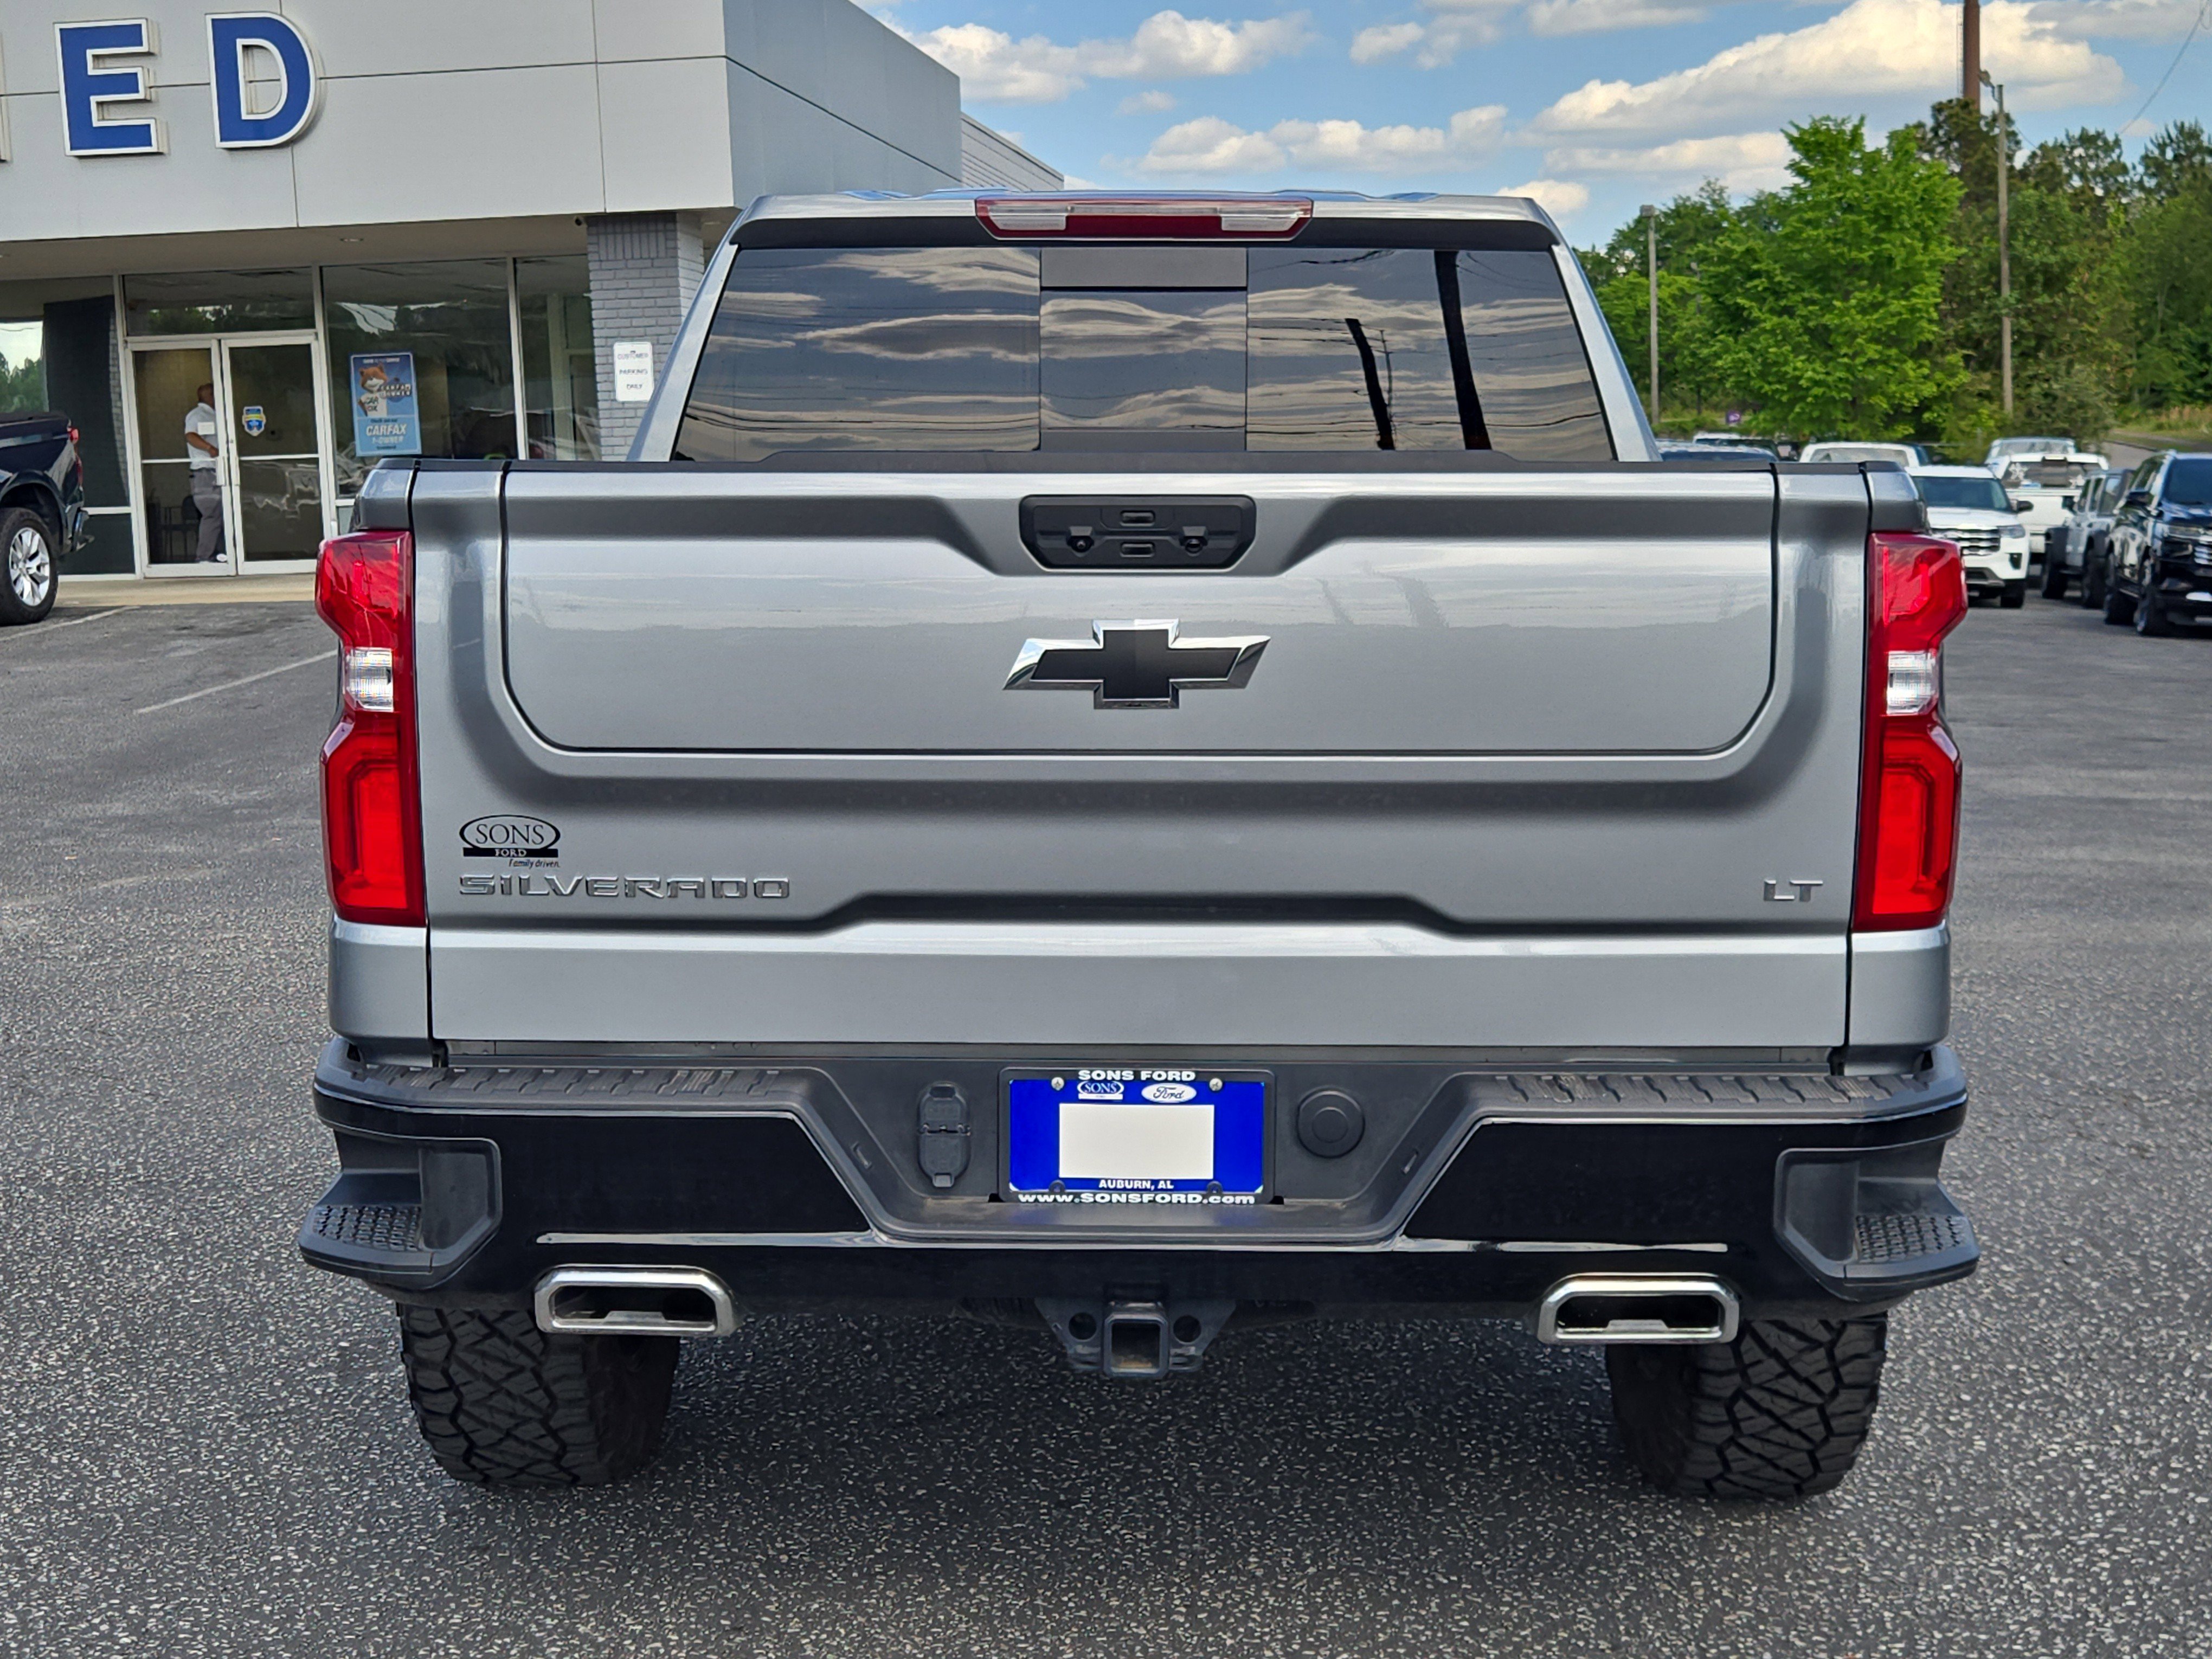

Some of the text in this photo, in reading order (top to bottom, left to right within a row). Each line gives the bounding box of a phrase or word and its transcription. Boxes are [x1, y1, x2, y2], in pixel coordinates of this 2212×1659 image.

[366, 423, 407, 436] CARFAX
[475, 824, 545, 845] SONS
[495, 848, 527, 857] FORD
[459, 874, 790, 899] SILVERADO
[1763, 879, 1824, 903] LT
[1078, 1070, 1196, 1081] SONS FORD
[1084, 1082, 1117, 1094] SONS
[1153, 1085, 1186, 1099] Ford
[1098, 1179, 1174, 1191] AUBURN, AL
[1018, 1193, 1256, 1205] www.SONSFORD.com
